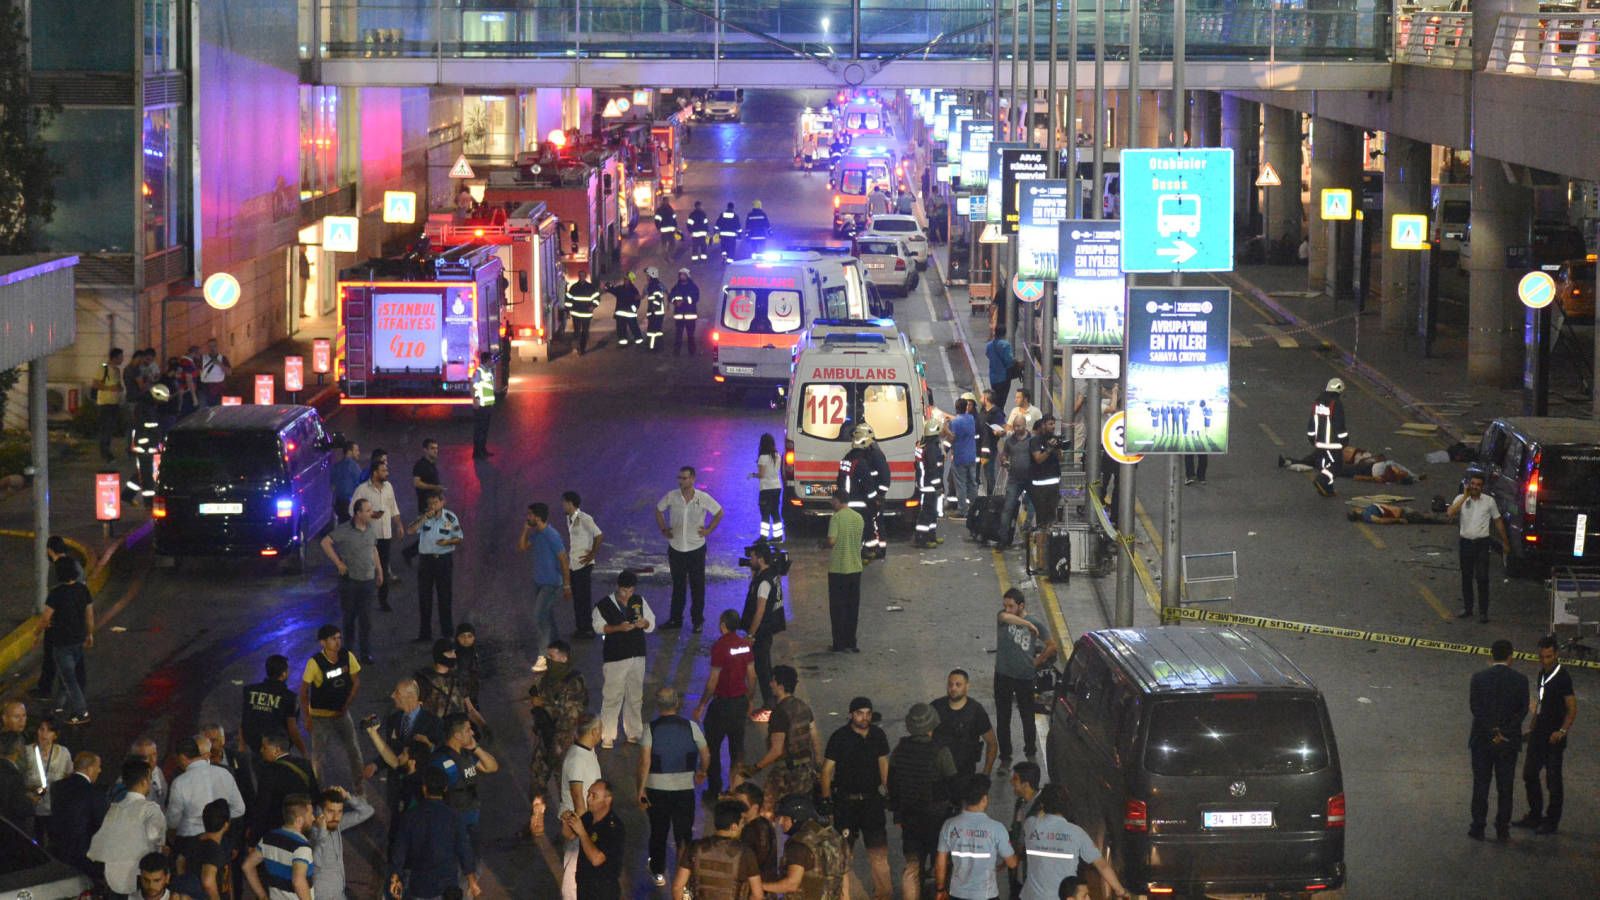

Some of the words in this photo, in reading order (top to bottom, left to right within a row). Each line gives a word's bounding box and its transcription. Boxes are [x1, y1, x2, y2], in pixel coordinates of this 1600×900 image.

[1151, 320, 1207, 333] AVRUPA'NIN
[395, 341, 427, 358] 110
[1150, 335, 1165, 350] EN
[812, 367, 896, 380] AMBULANS
[806, 395, 844, 425] 112
[249, 691, 282, 709] TEM
[1212, 814, 1224, 825] 34
[1232, 814, 1243, 825] HT
